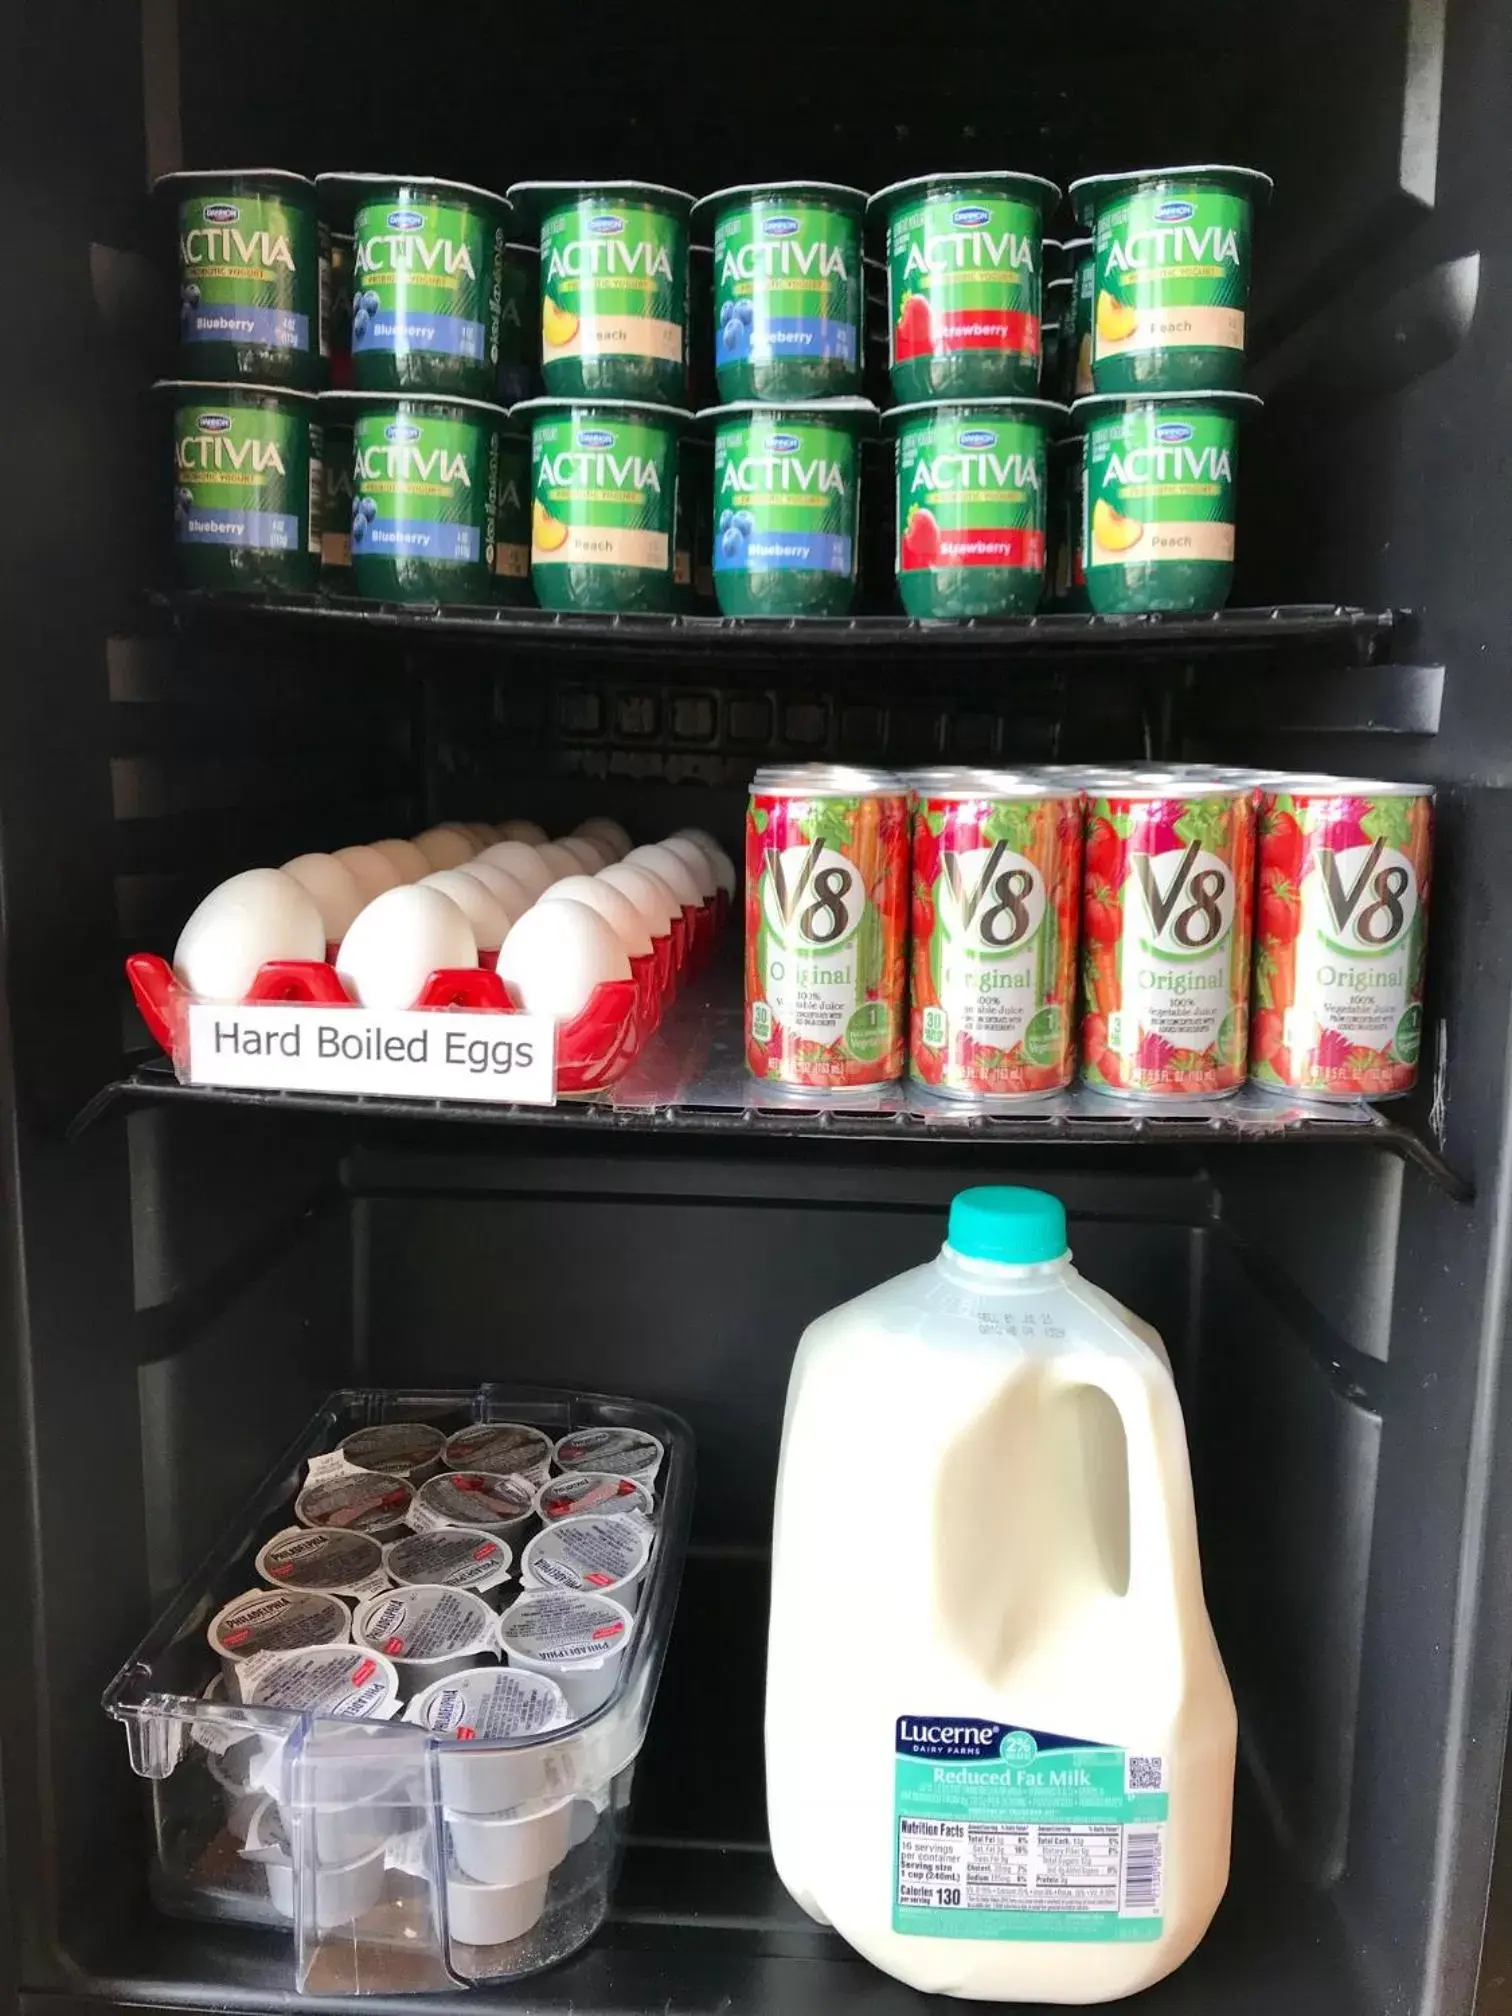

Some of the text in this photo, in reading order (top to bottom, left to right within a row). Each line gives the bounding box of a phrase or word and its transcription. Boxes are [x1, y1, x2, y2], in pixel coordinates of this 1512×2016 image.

[354, 235, 476, 281] ACTIVIA
[547, 240, 673, 284] ACTIVIA
[721, 241, 848, 287] ACTIVIA
[903, 231, 1034, 280] ACTIVIA
[1104, 226, 1240, 277] ACTIVIA
[196, 318, 255, 333] Blueberry
[373, 321, 435, 340] Blueberry
[594, 329, 627, 342] each
[354, 446, 471, 488] ACTIVIA
[538, 452, 661, 493] ACTIVIA
[722, 457, 845, 496] ACTIVIA
[911, 453, 1039, 493] ACTIVIA
[1102, 446, 1232, 488] ACTIVIA
[188, 520, 245, 536] Blueberry
[371, 531, 431, 547] Blueberry
[574, 539, 613, 554] Peach
[748, 543, 811, 560] Blueberry
[940, 538, 1011, 557] Strawberry
[1151, 536, 1192, 550] Peach
[764, 836, 853, 943] V8
[941, 838, 1034, 946] V8
[1131, 839, 1226, 947] V8
[1313, 835, 1408, 944] V8
[770, 961, 851, 990] Oiginal
[1138, 968, 1224, 994] Original
[1316, 966, 1402, 991] Original
[926, 1012, 942, 1029] 30
[215, 1021, 534, 1074] Hard Boiled Eggs
[271, 1535, 330, 1562] PHILADELPHIA
[225, 1597, 291, 1629] PHILADELPHIA
[538, 1641, 610, 1661] PHILADELPHIA
[343, 1683, 385, 1718] PHILADEL
[900, 1720, 994, 1745] Lucerne
[1006, 1737, 1031, 1753] 2%
[913, 1745, 981, 1756] DAIRY FARMS
[933, 1767, 1092, 1786] Reduced Fat Milk
[901, 1820, 939, 1836] Nutrition
[940, 1823, 965, 1838] Facts
[901, 1852, 961, 1863] per container
[902, 1841, 954, 1854] 16 servings
[901, 1861, 952, 1872] Serving size
[907, 1871, 924, 1880] cup
[925, 1871, 961, 1882] (240mL)
[901, 1884, 934, 1897] Calories
[936, 1888, 961, 1905] 130
